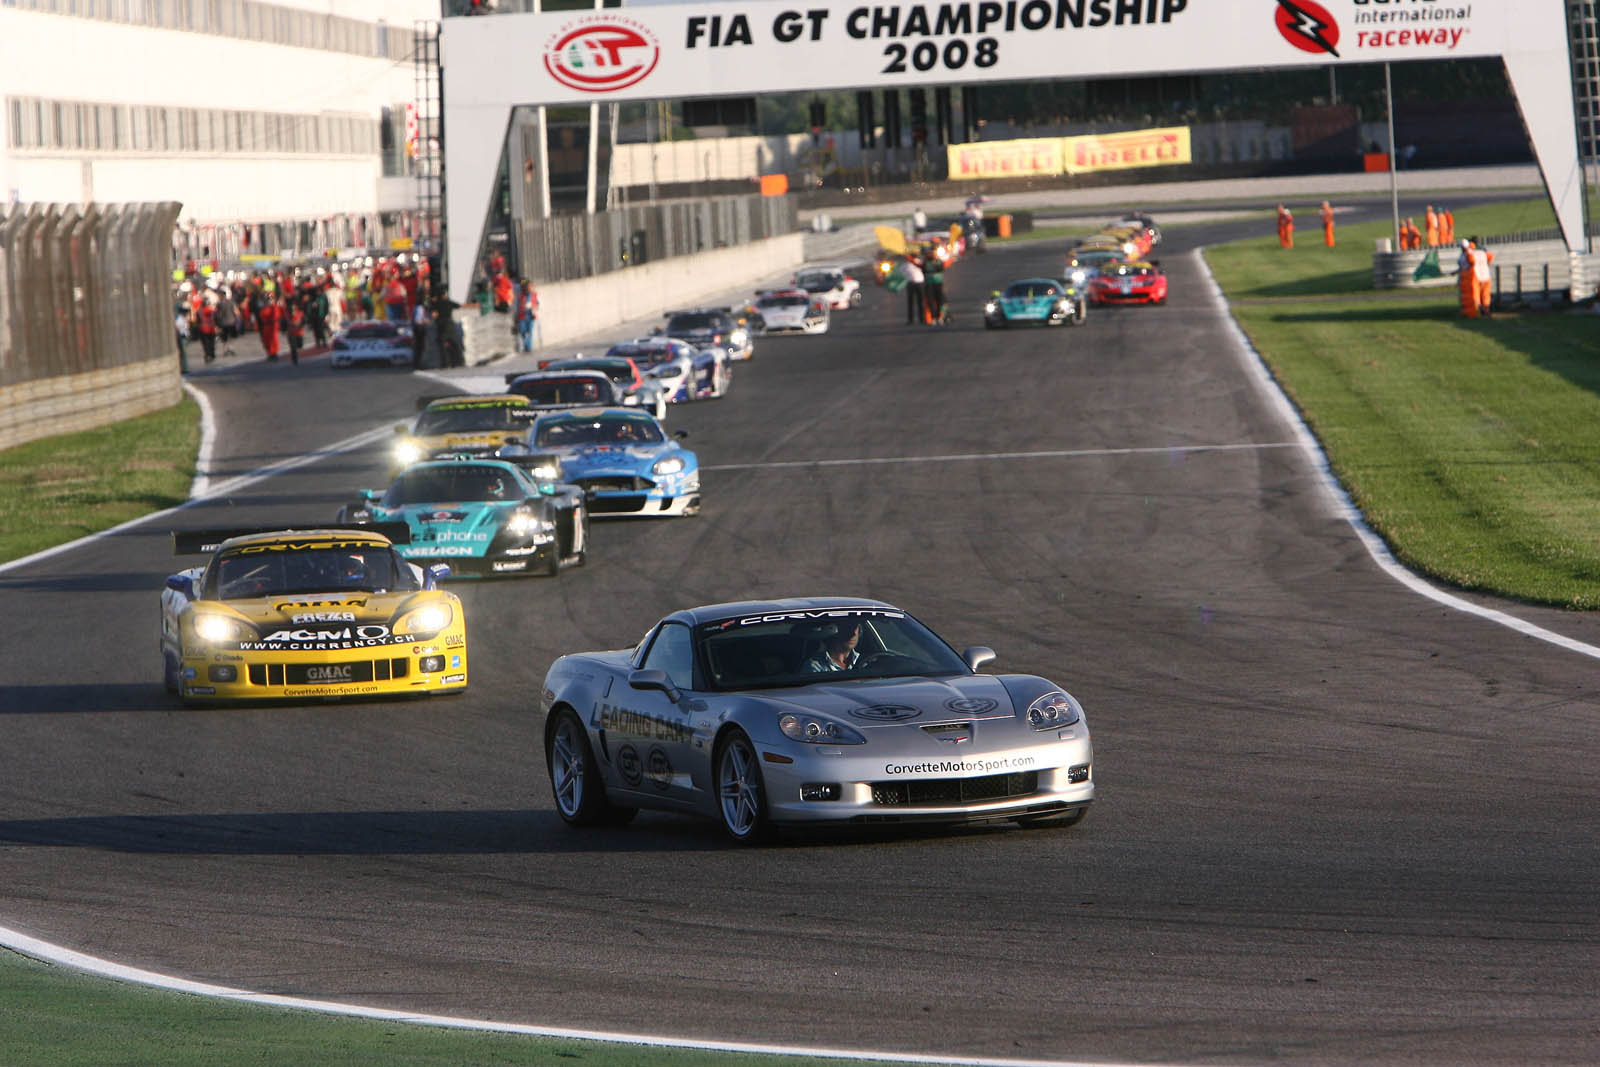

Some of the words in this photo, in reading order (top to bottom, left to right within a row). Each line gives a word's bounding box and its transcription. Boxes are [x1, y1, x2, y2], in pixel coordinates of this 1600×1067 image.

[1354, 4, 1471, 23] international
[686, 14, 753, 49] FIA
[773, 9, 829, 43] GT
[846, 0, 1187, 39] CHAMPIONSHIP
[1356, 27, 1463, 49] raceway
[881, 37, 999, 73] 2008
[1075, 134, 1178, 166] PIRELLI
[740, 610, 905, 626] CORVETTE
[306, 665, 352, 679] GMAC
[283, 685, 378, 697] CorvetteMotorSport.com
[885, 756, 1036, 775] CorvetteMotorSport.com
